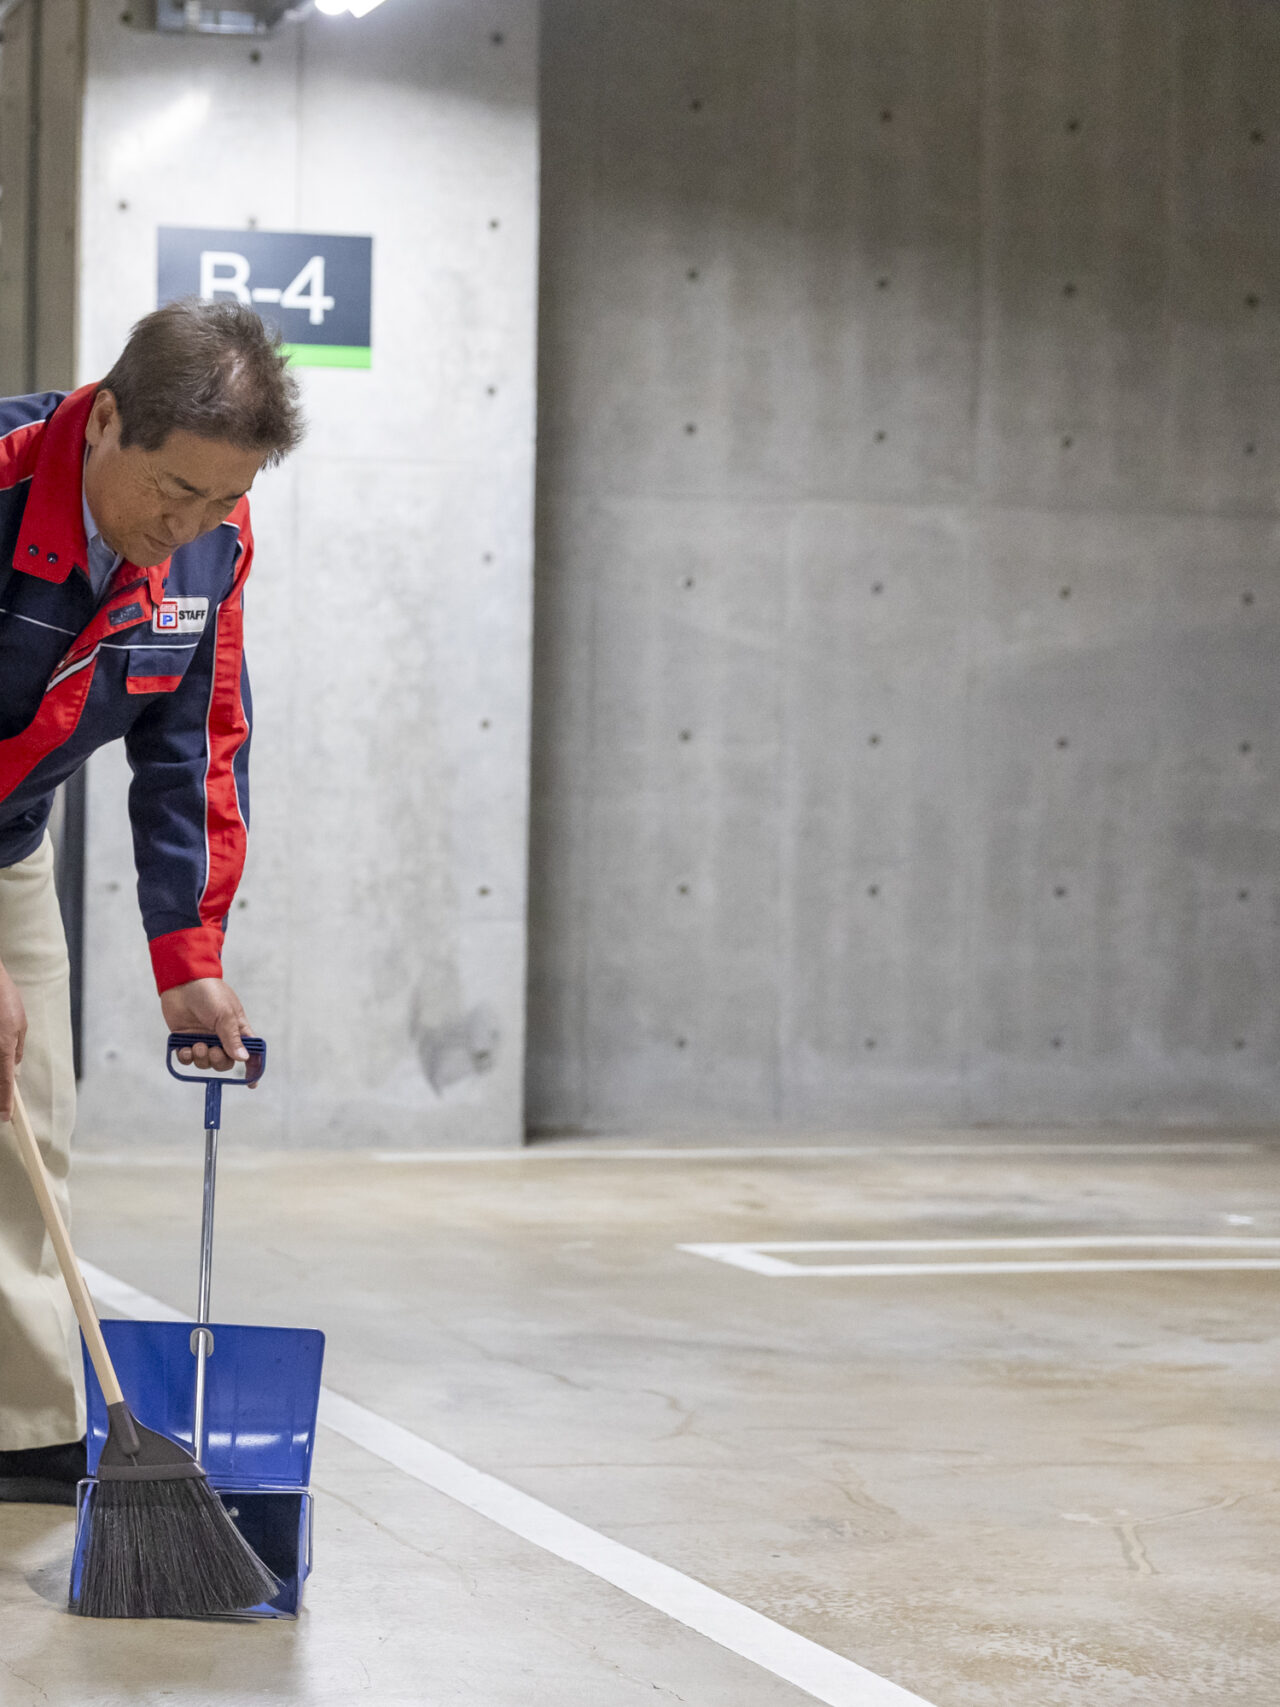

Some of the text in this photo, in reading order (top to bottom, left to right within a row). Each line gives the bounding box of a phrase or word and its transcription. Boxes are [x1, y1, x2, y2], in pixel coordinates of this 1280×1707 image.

[200, 251, 336, 325] B-4
[162, 614, 173, 626] P
[178, 610, 206, 620] STAFF
